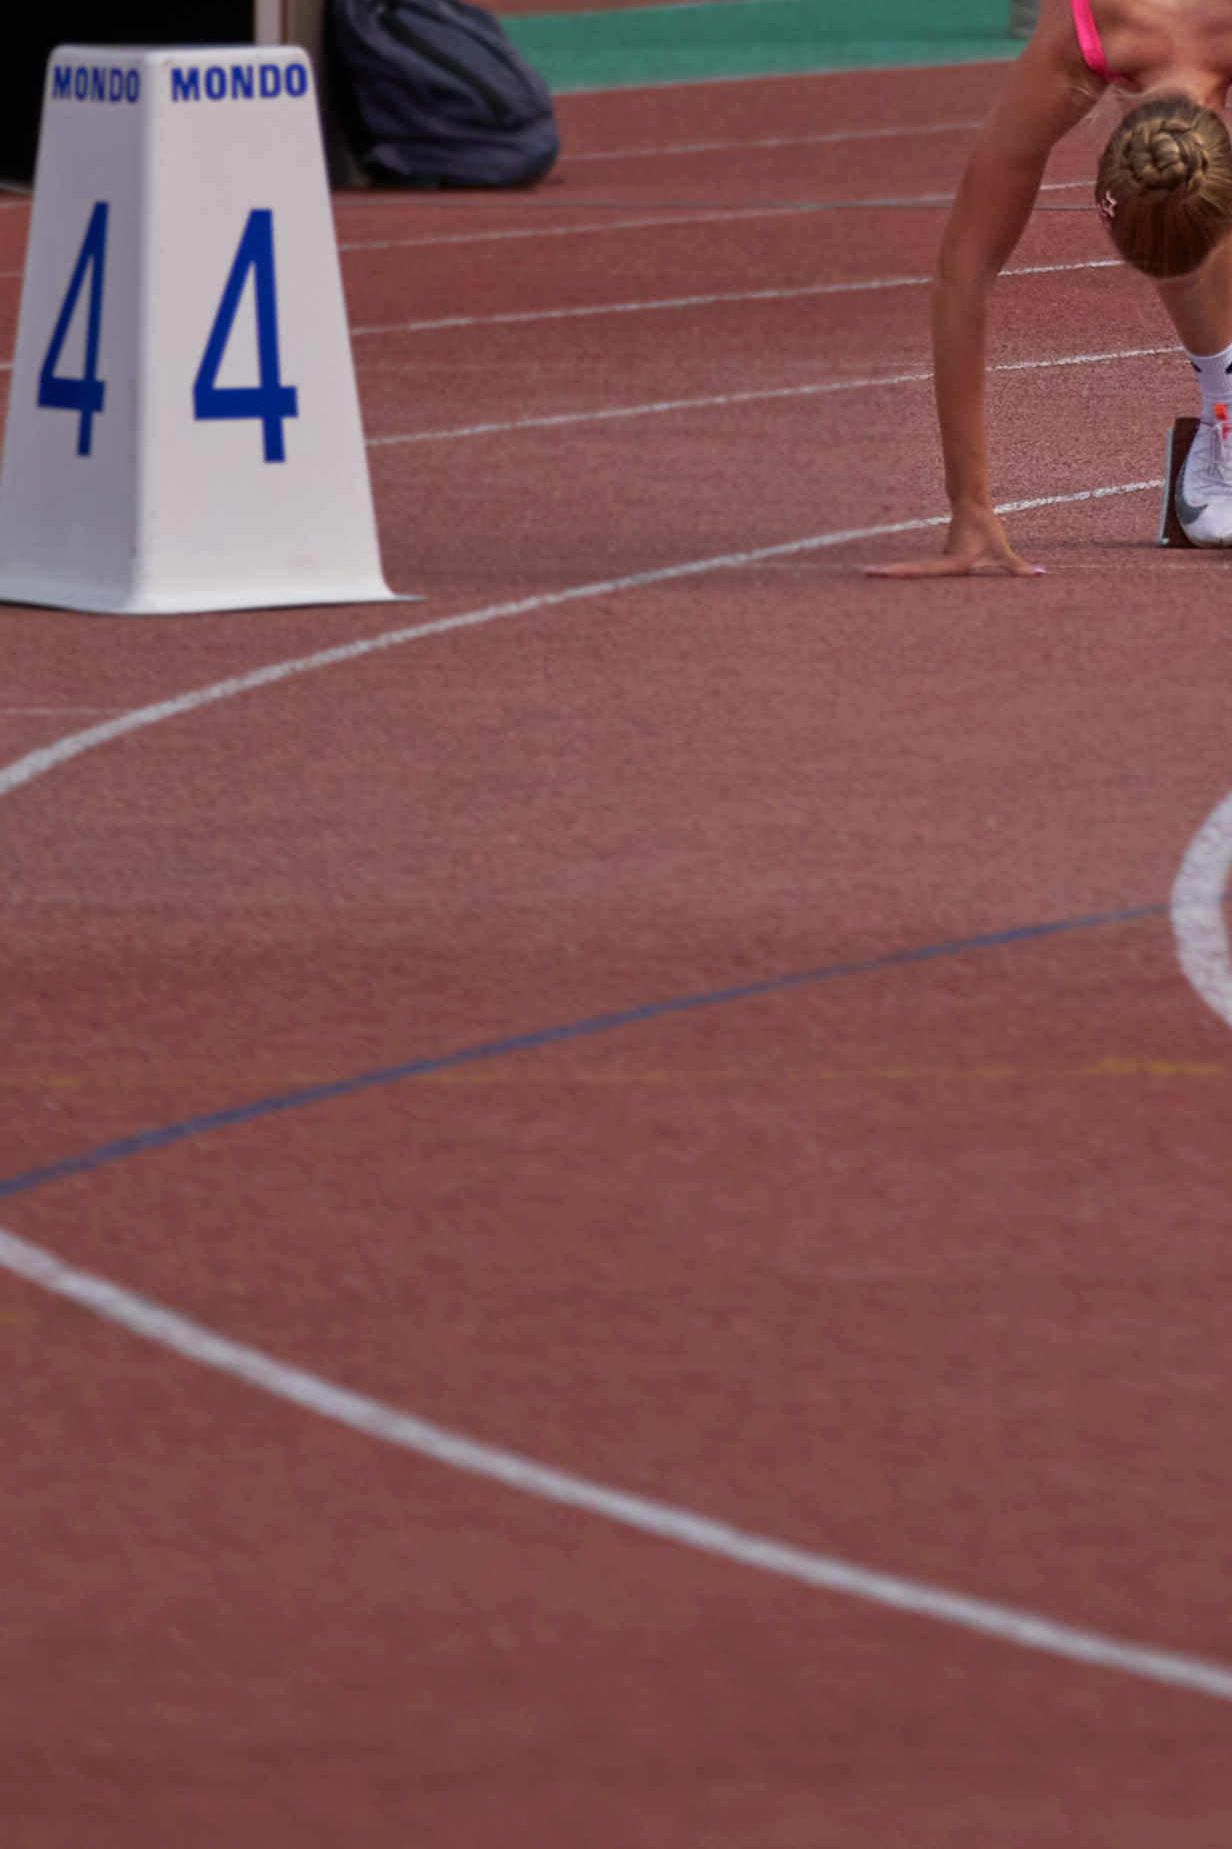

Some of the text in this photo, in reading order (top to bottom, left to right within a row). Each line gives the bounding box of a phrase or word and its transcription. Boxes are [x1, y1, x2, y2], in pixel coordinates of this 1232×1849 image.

[51, 65, 141, 105] MONDO
[170, 62, 308, 102] MONDO
[37, 201, 109, 457] 4
[192, 209, 299, 464] 4
